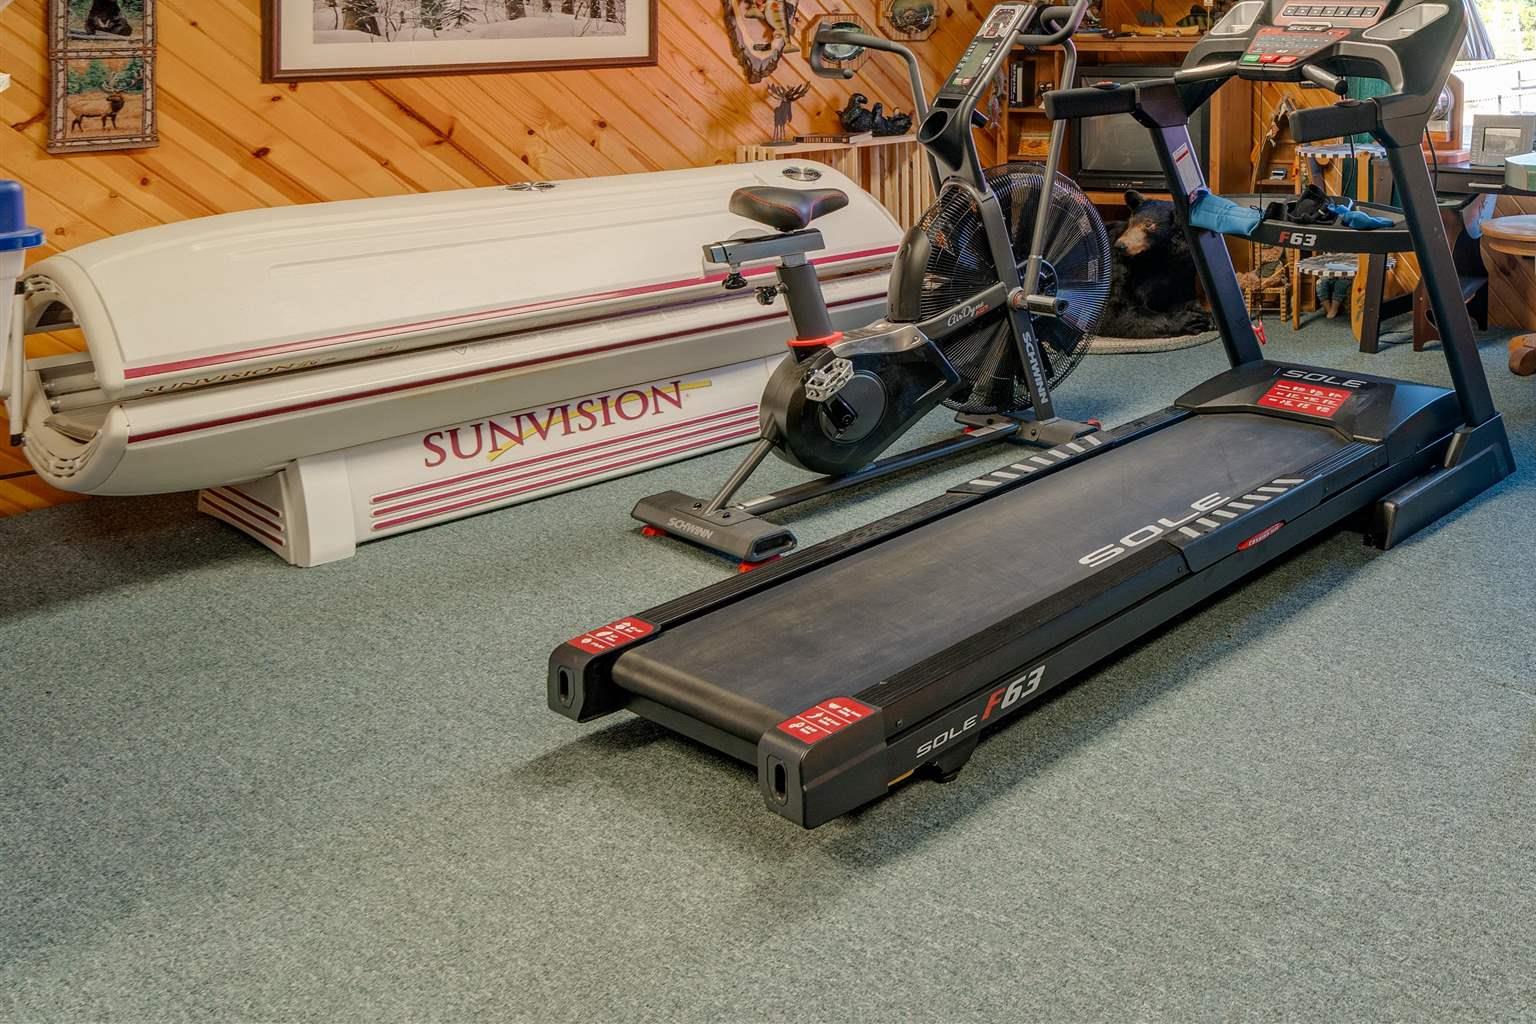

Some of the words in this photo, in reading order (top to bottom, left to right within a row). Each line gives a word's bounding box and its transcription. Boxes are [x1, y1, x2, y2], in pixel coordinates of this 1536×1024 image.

[1279, 231, 1317, 246] F63
[1022, 331, 1049, 405] SCHWINN
[1282, 369, 1368, 388] SOLE
[422, 380, 682, 468] SUNVISION
[667, 517, 714, 539] SCHWINN
[1078, 492, 1231, 568] SOLE
[980, 665, 1046, 721] F63
[916, 714, 979, 759] SOLE
